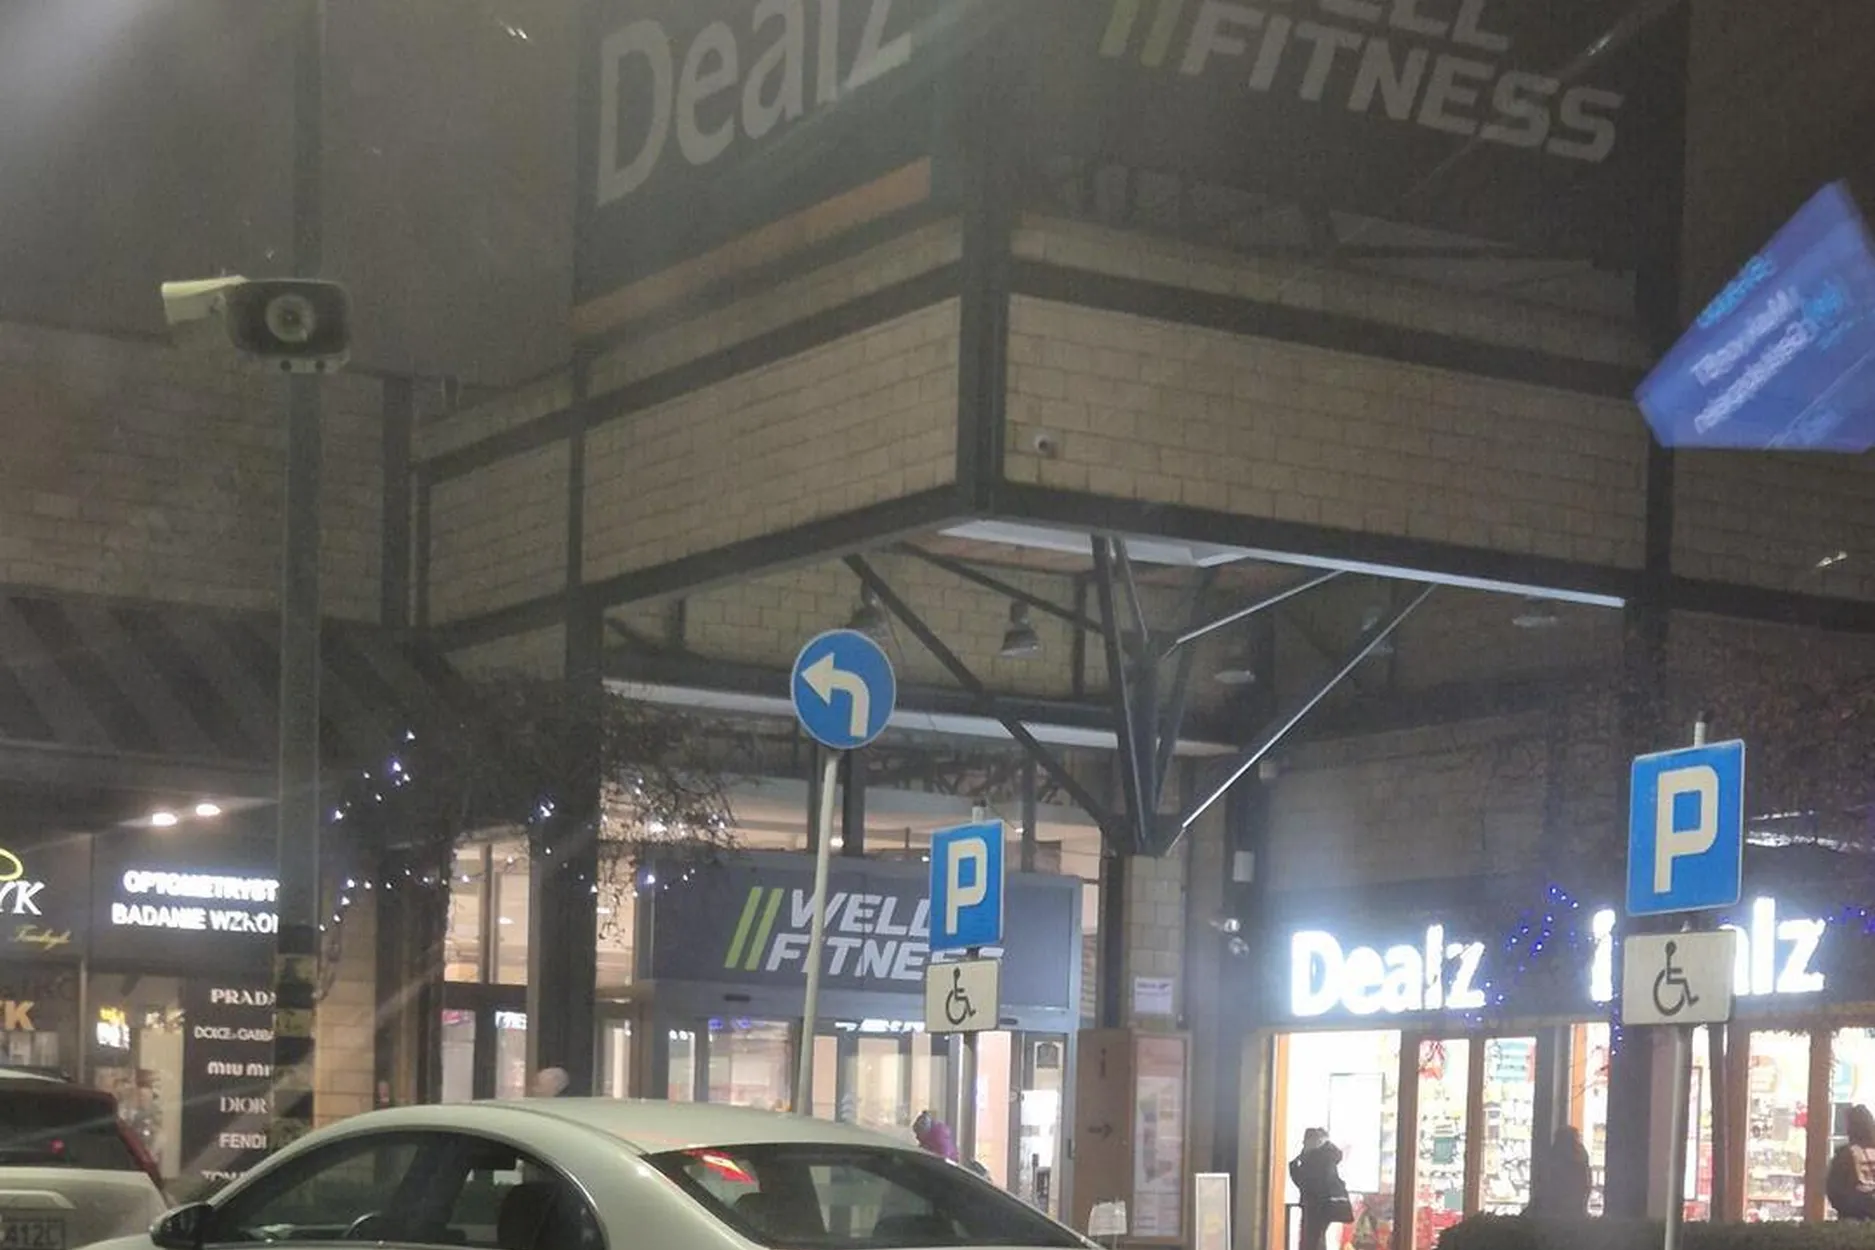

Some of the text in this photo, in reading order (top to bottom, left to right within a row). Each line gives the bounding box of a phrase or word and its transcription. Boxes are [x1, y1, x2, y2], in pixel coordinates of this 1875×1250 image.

[1179, 6, 1625, 164] FITNESS
[1652, 765, 1720, 894] P
[111, 902, 207, 930] BADANIE
[945, 838, 987, 935] P
[1291, 924, 1486, 1017] Dealz
[219, 1096, 268, 1114] DIOR
[219, 1133, 267, 1149] FENDI
